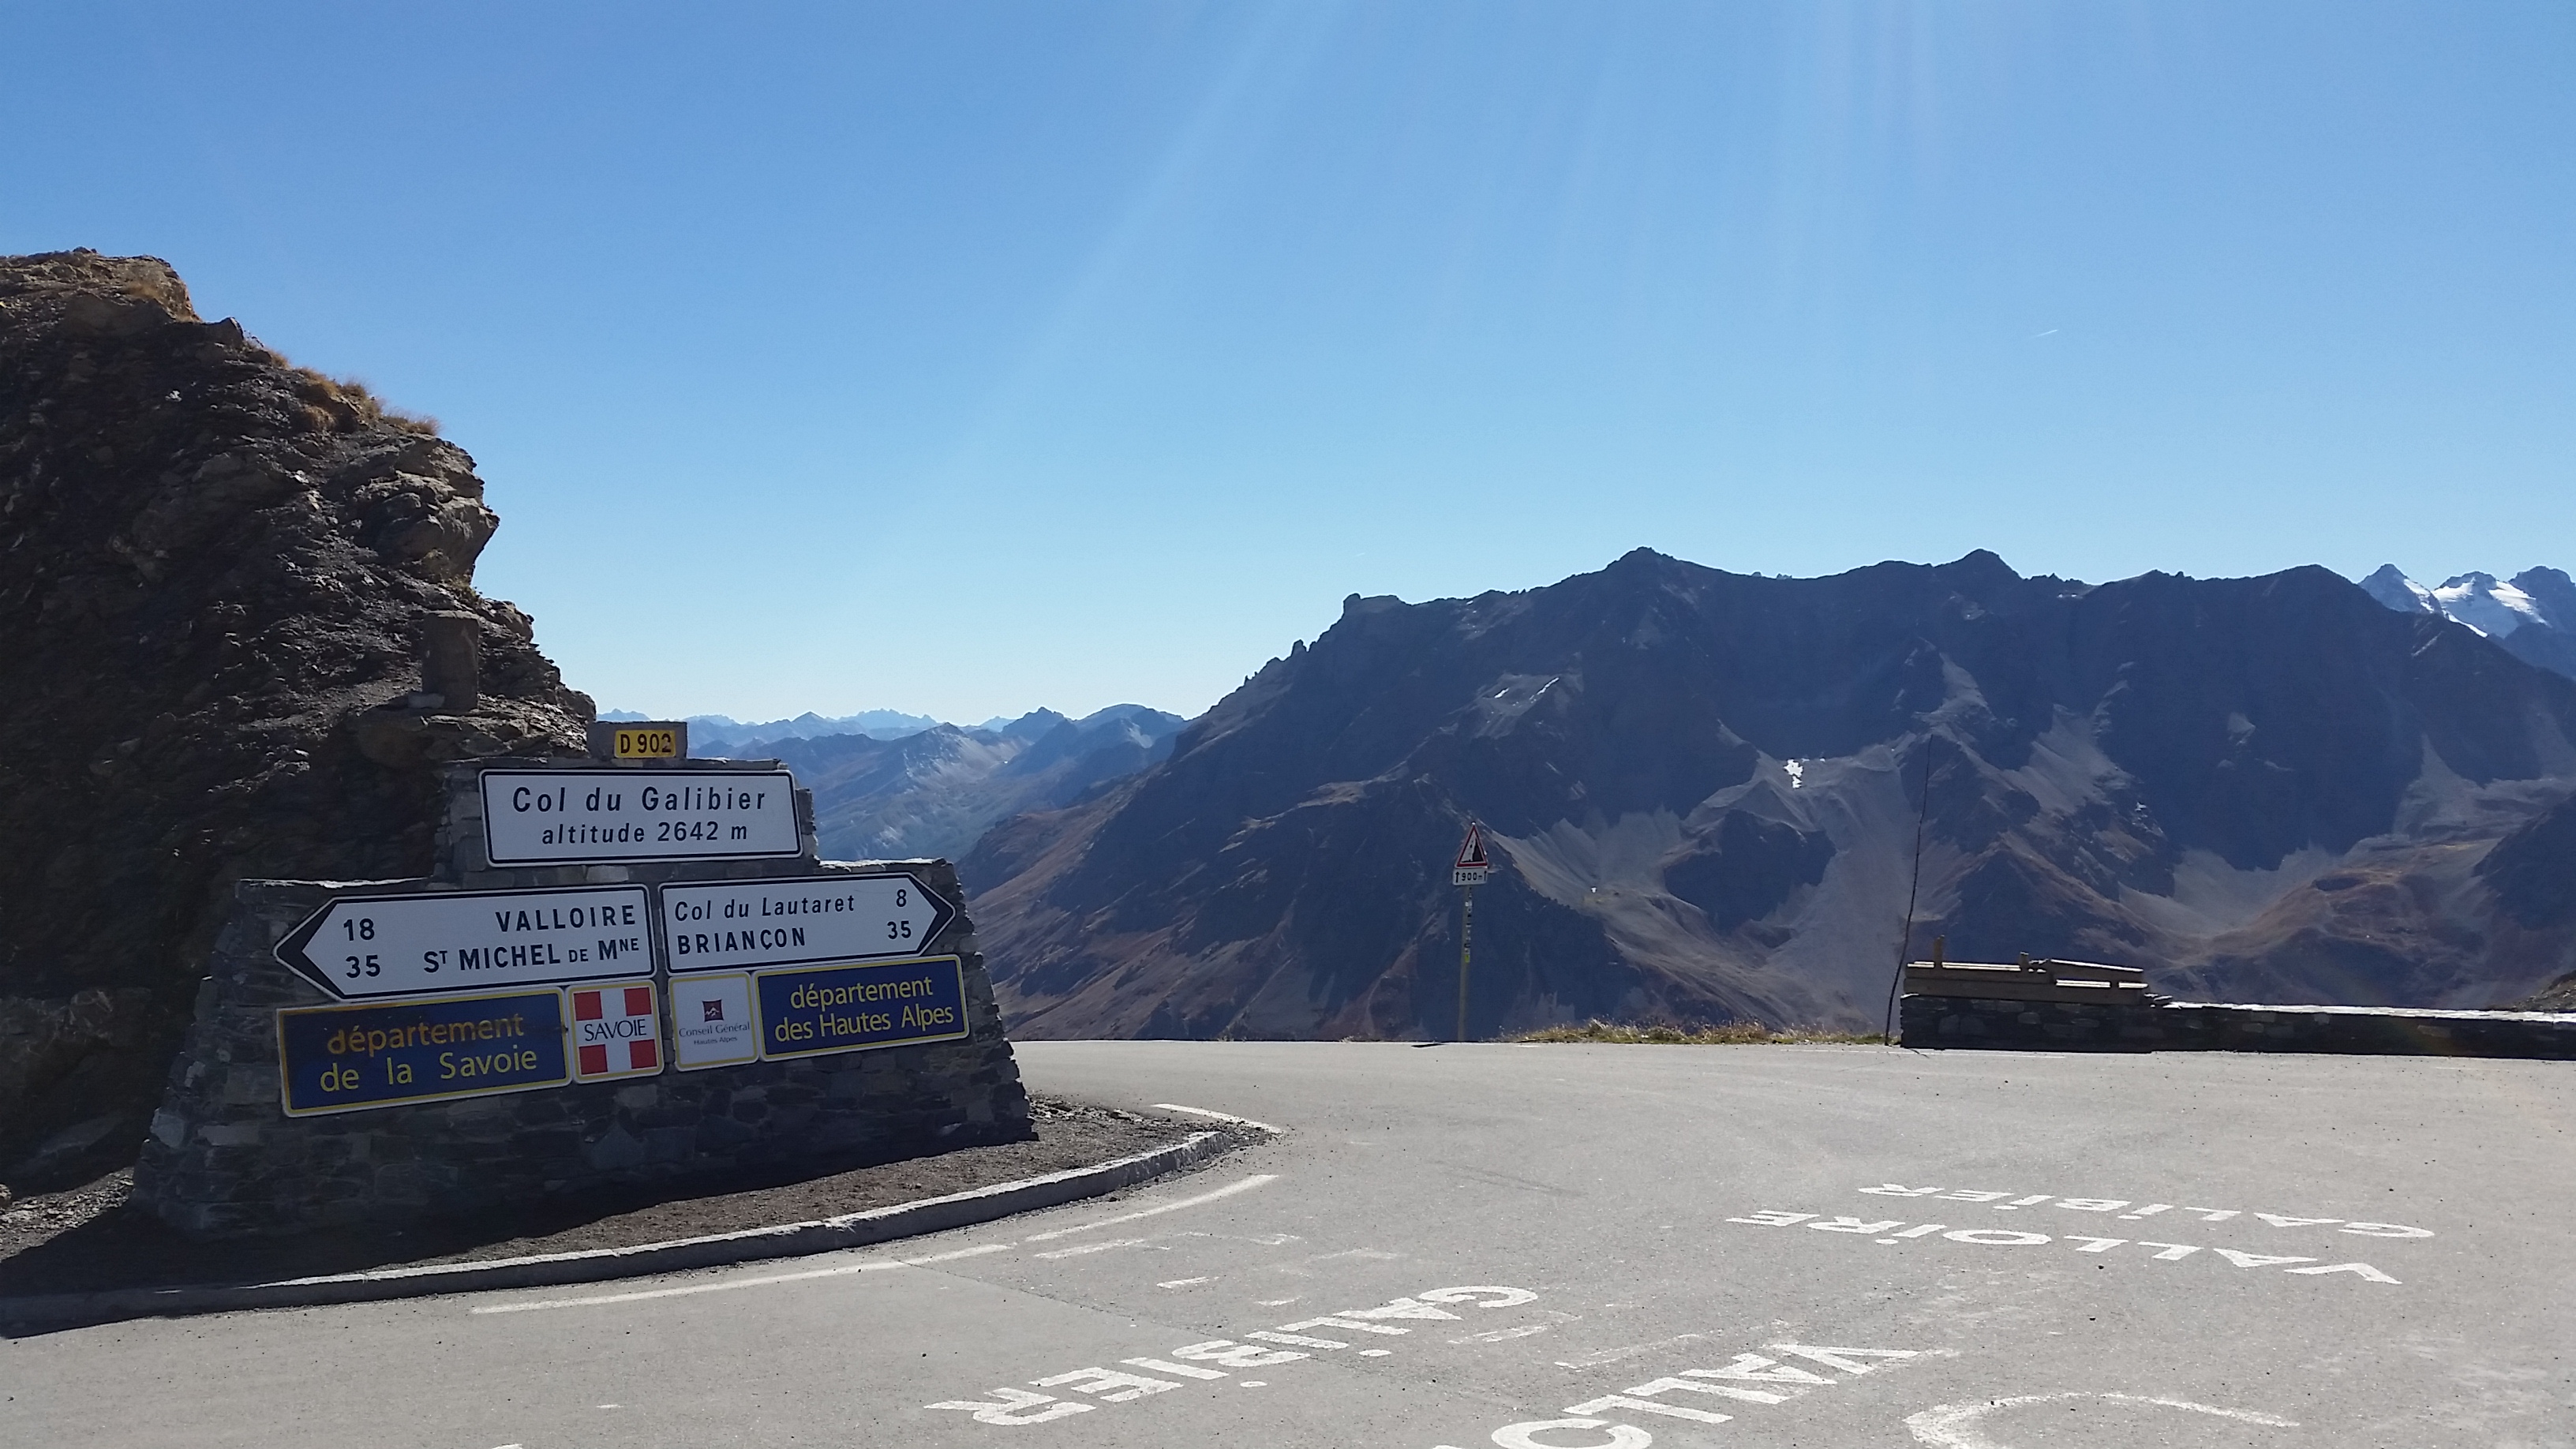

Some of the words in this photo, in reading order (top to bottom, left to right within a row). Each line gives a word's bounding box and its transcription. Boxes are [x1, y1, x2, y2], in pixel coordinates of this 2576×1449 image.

[620, 734, 630, 753] D
[637, 733, 672, 753] 902
[513, 787, 565, 812] Col
[586, 787, 621, 811] du
[642, 786, 765, 811] Galibier
[541, 823, 645, 844] altitude
[657, 822, 718, 841] 2642
[731, 826, 747, 840] m
[675, 900, 711, 922] Col
[724, 898, 749, 918] du
[762, 895, 854, 916] Lautaret
[896, 889, 907, 907] 8
[343, 918, 375, 941] 18
[496, 904, 636, 932] VALLOIRE
[887, 920, 912, 939] 35
[677, 927, 805, 955] BRIANÇON
[346, 955, 380, 979] 35
[459, 944, 560, 971] MICHEL
[569, 949, 588, 963] DE
[791, 976, 933, 1012] département
[327, 1013, 524, 1057] département
[584, 1019, 647, 1042] SAVOIE
[679, 1025, 713, 1037] Conseil
[715, 1021, 750, 1034] Général
[775, 1018, 813, 1042] des
[819, 1009, 891, 1037] Hautes
[901, 1003, 954, 1032] Alpes
[320, 1063, 359, 1092] de
[387, 1058, 412, 1085] la
[440, 1045, 537, 1080] Savoie
